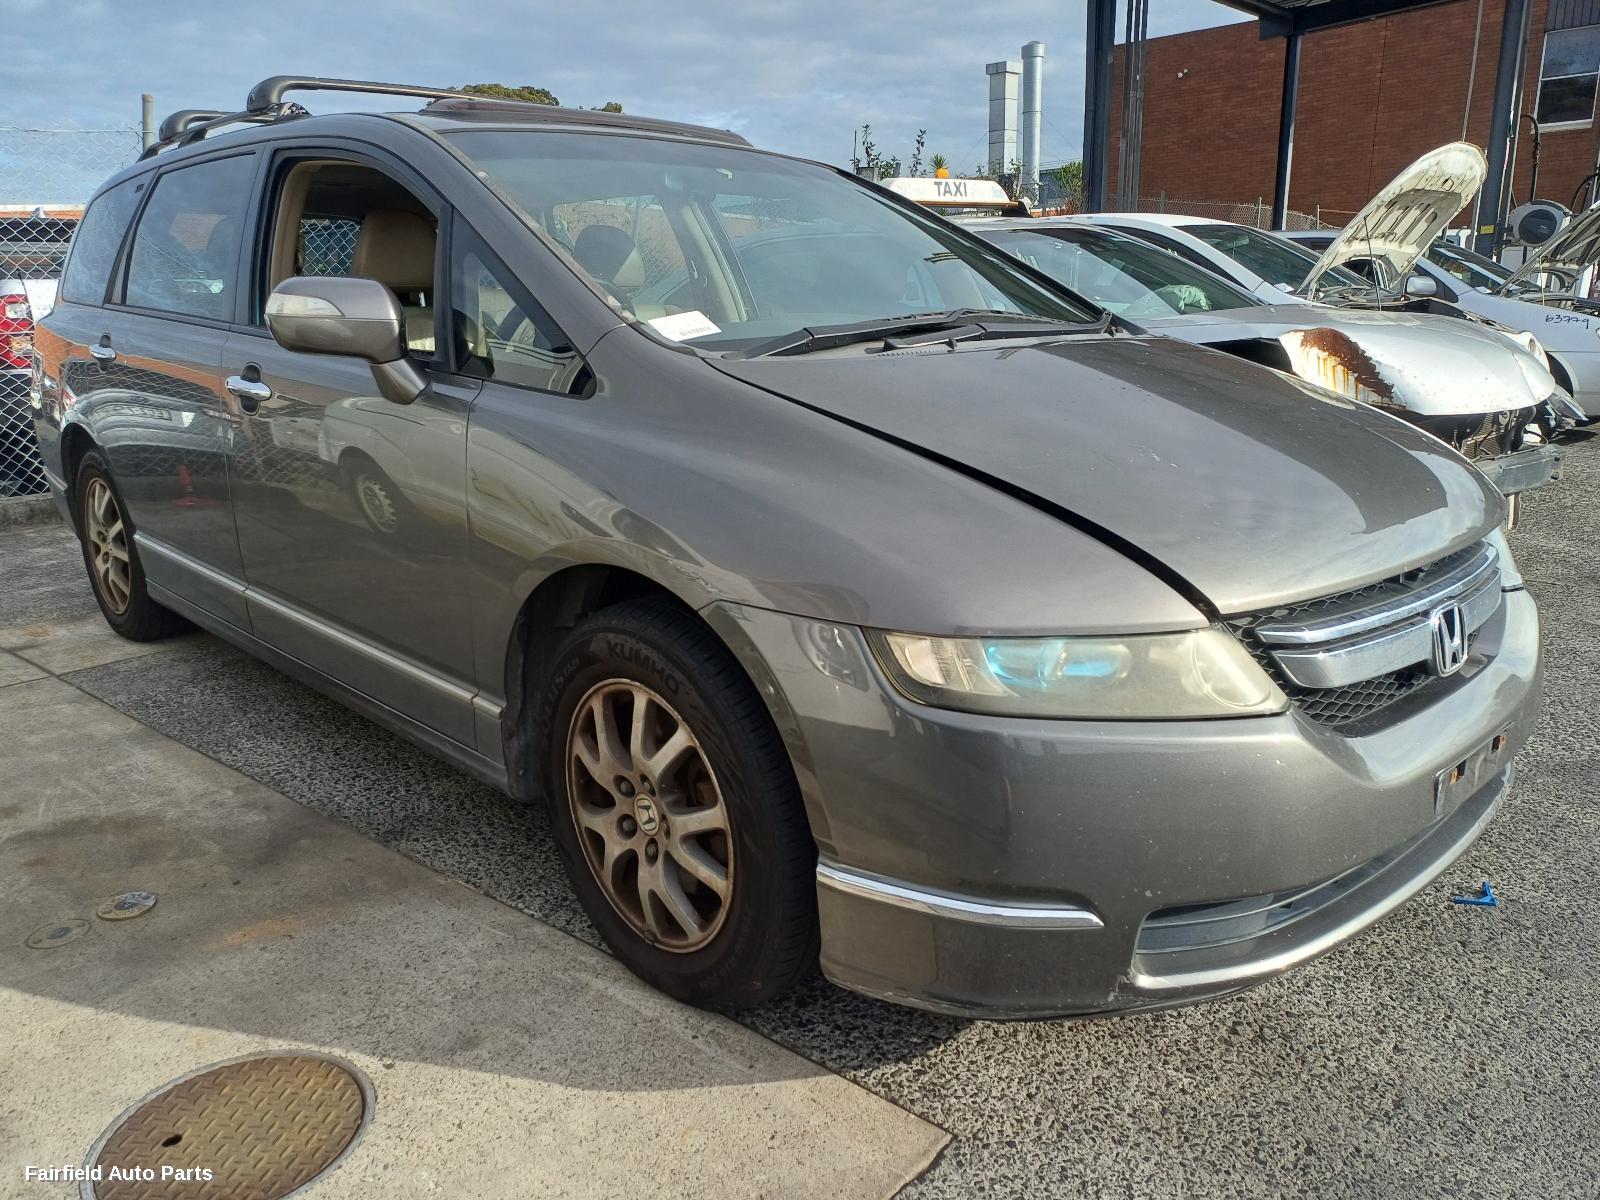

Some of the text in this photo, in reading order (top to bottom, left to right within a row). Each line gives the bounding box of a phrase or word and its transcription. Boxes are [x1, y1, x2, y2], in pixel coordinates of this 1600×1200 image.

[933, 181, 968, 197] TAXI
[1545, 314, 1590, 330] 63779
[607, 640, 680, 695] KUMHO
